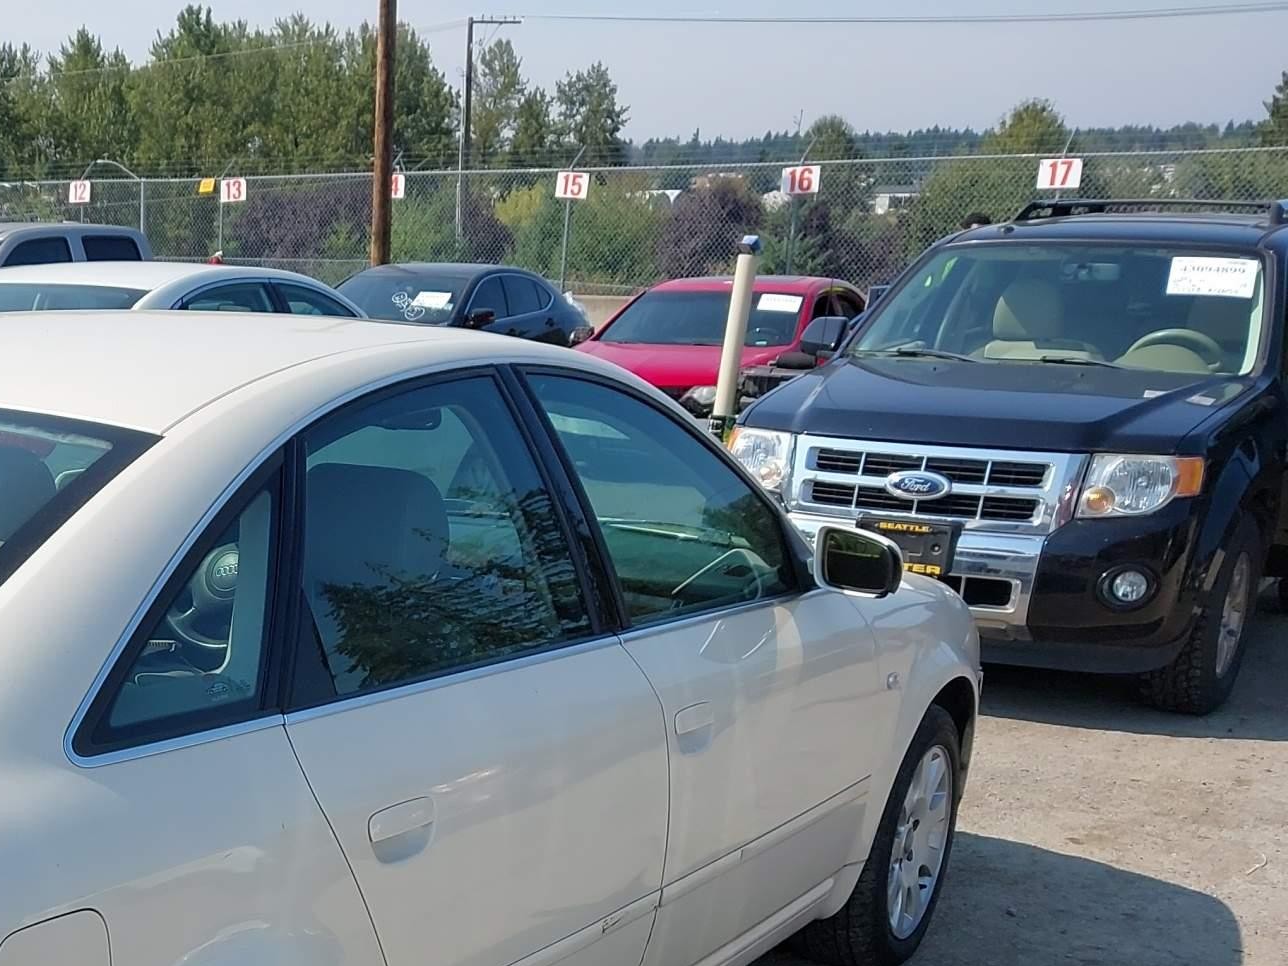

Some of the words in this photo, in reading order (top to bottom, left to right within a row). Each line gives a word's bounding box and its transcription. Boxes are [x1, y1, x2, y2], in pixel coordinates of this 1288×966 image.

[789, 168, 813, 193] 16
[1049, 160, 1074, 186] 17
[73, 183, 87, 201] 12
[225, 180, 242, 201] 13
[563, 174, 583, 196] 15
[900, 477, 931, 492] Ford
[878, 521, 930, 533] SEATTLE
[903, 562, 942, 575] TER
